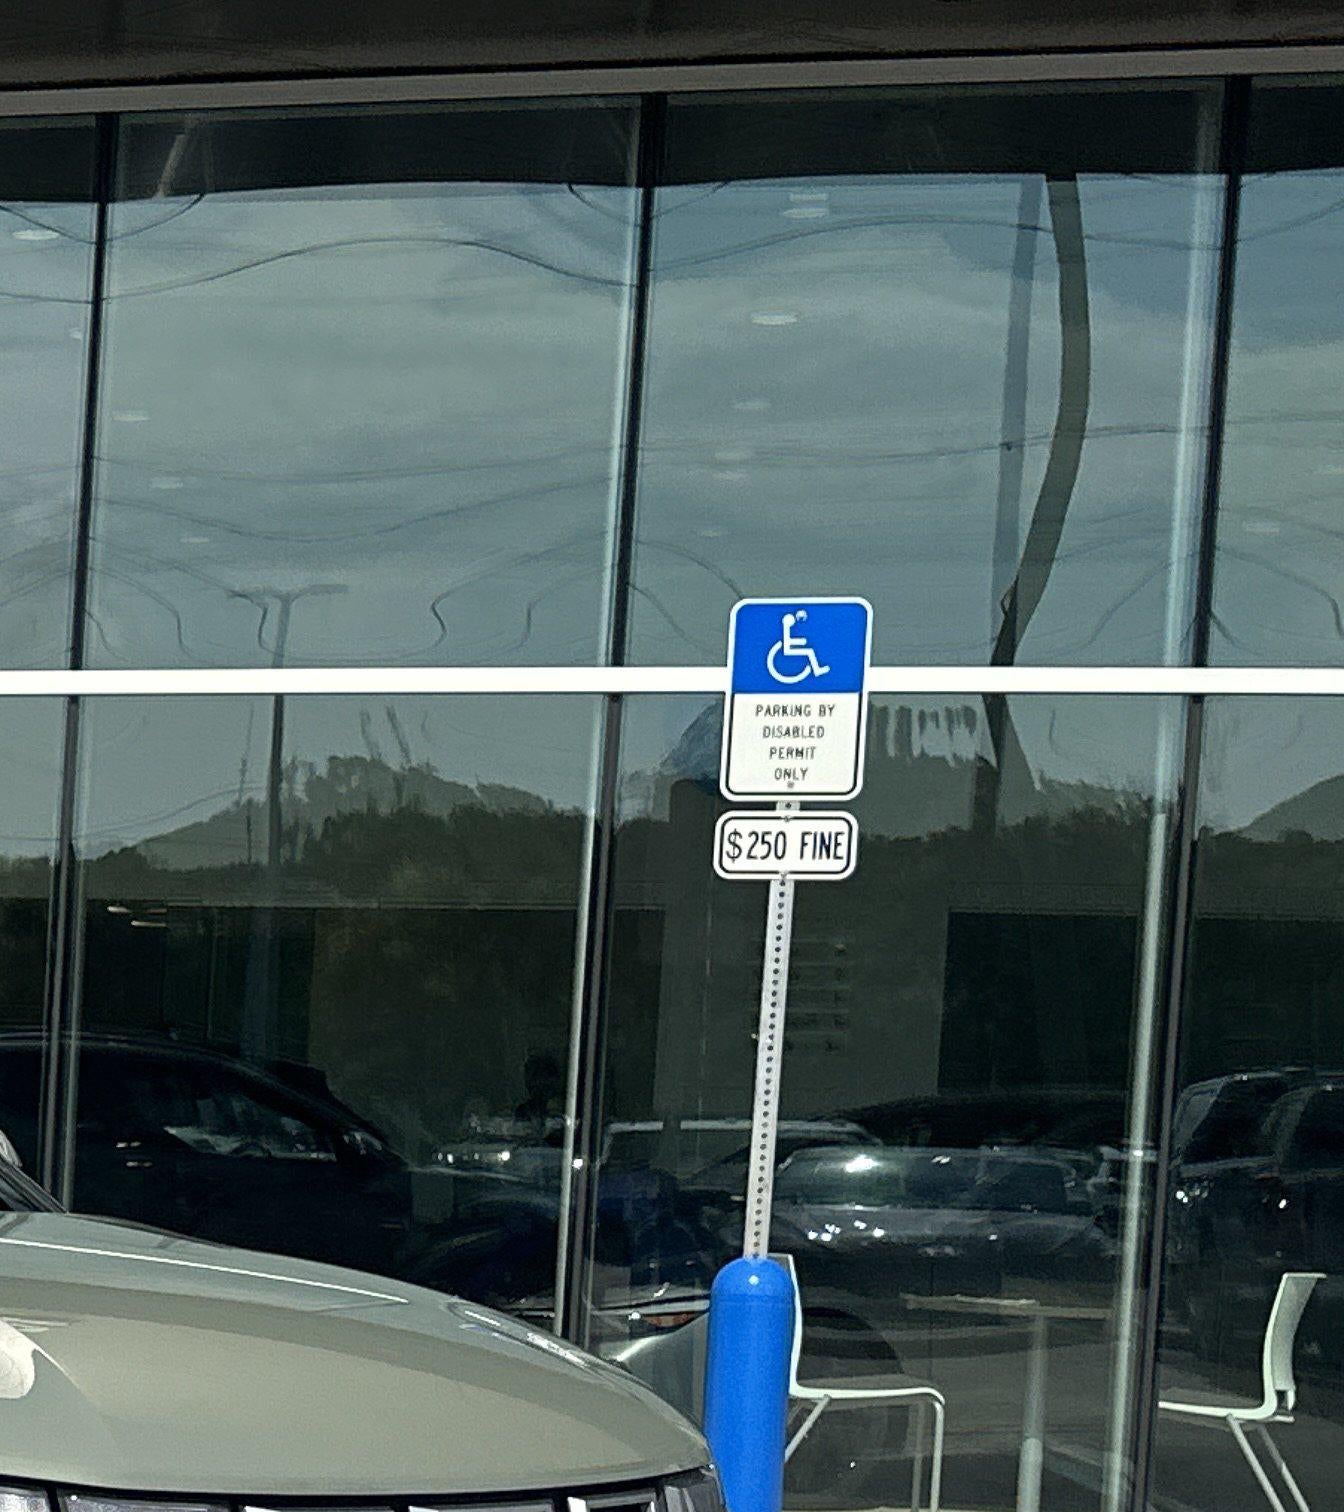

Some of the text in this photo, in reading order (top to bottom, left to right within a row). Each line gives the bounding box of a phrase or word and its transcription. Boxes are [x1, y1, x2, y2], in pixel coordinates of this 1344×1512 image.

[755, 703, 836, 718] PARKING BY
[762, 725, 825, 739] DISABLED
[769, 746, 816, 760] PERMIT
[774, 766, 809, 781] ONLY
[725, 828, 846, 863] $250 FINE
